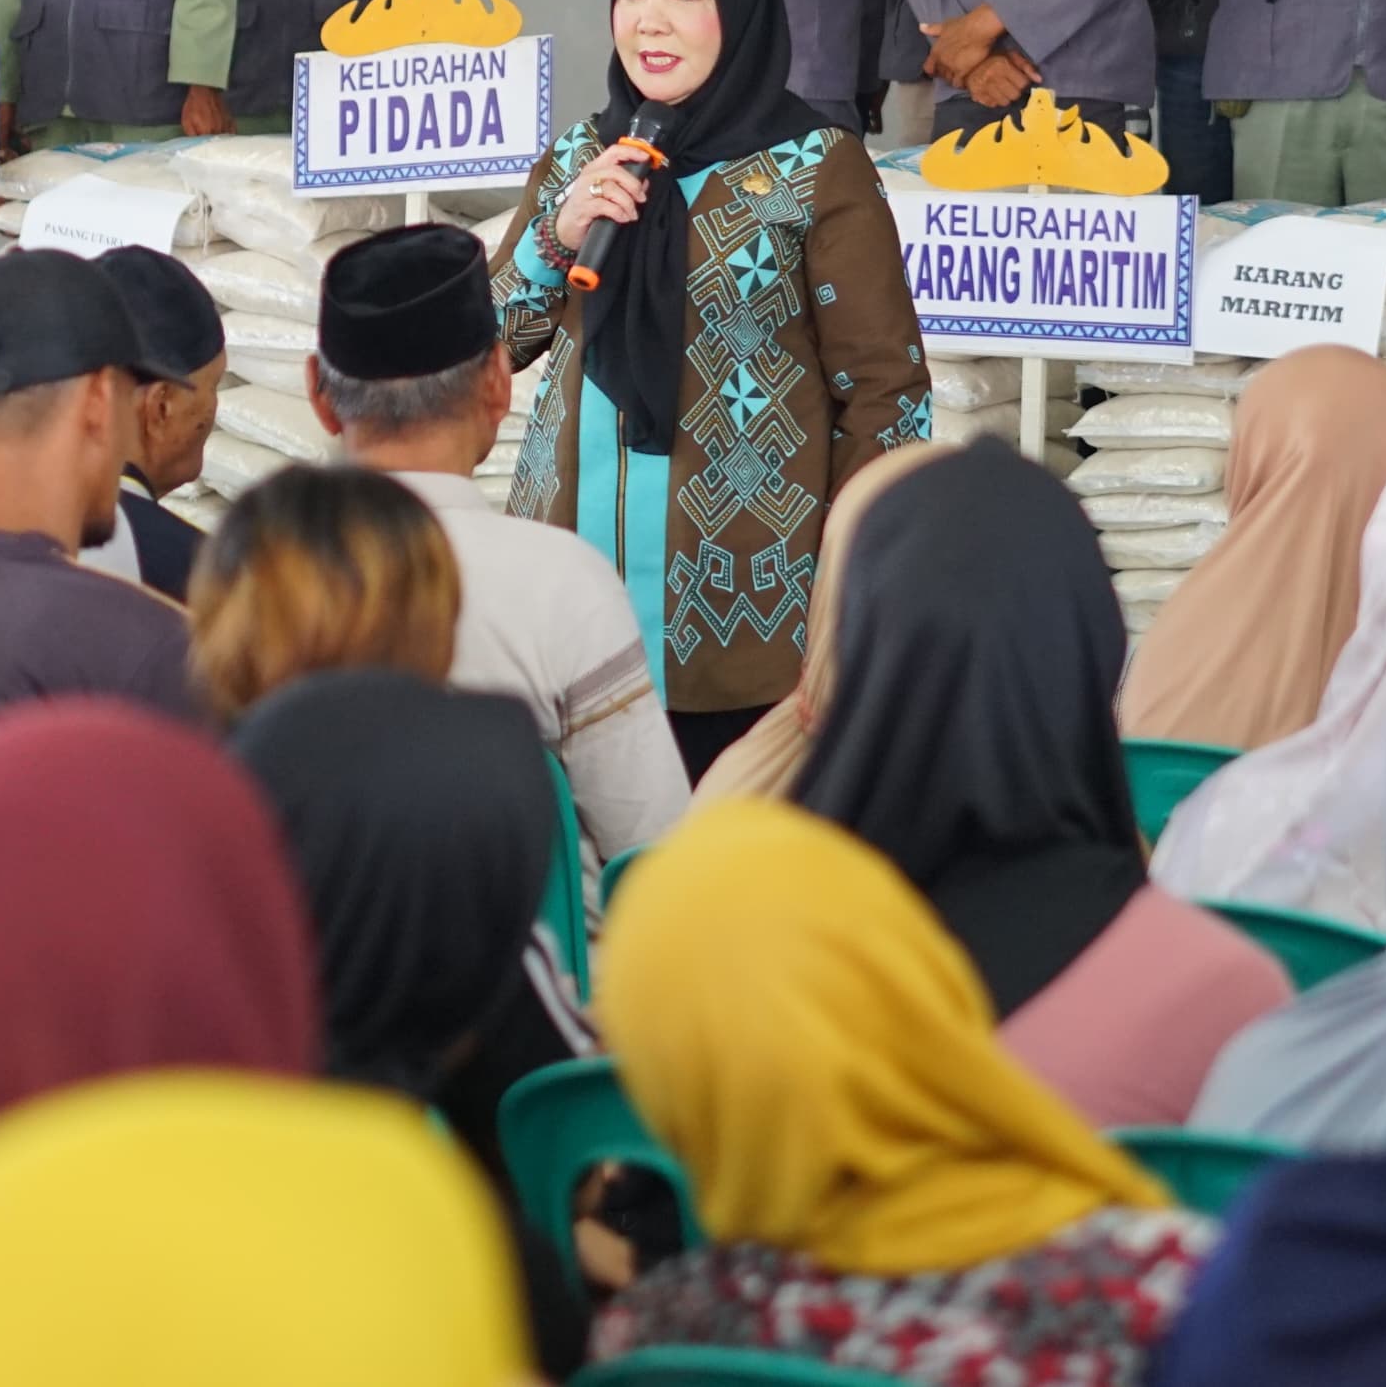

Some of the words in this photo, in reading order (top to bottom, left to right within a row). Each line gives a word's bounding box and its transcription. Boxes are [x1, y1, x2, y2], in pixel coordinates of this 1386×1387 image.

[339, 49, 507, 93] KELURAHAN
[338, 87, 505, 157] PIDADA
[925, 203, 1137, 244] KELURAHAN
[1031, 247, 1168, 310] MARITIM
[1233, 265, 1344, 291] KARANG
[1219, 294, 1344, 323] MARITIM
